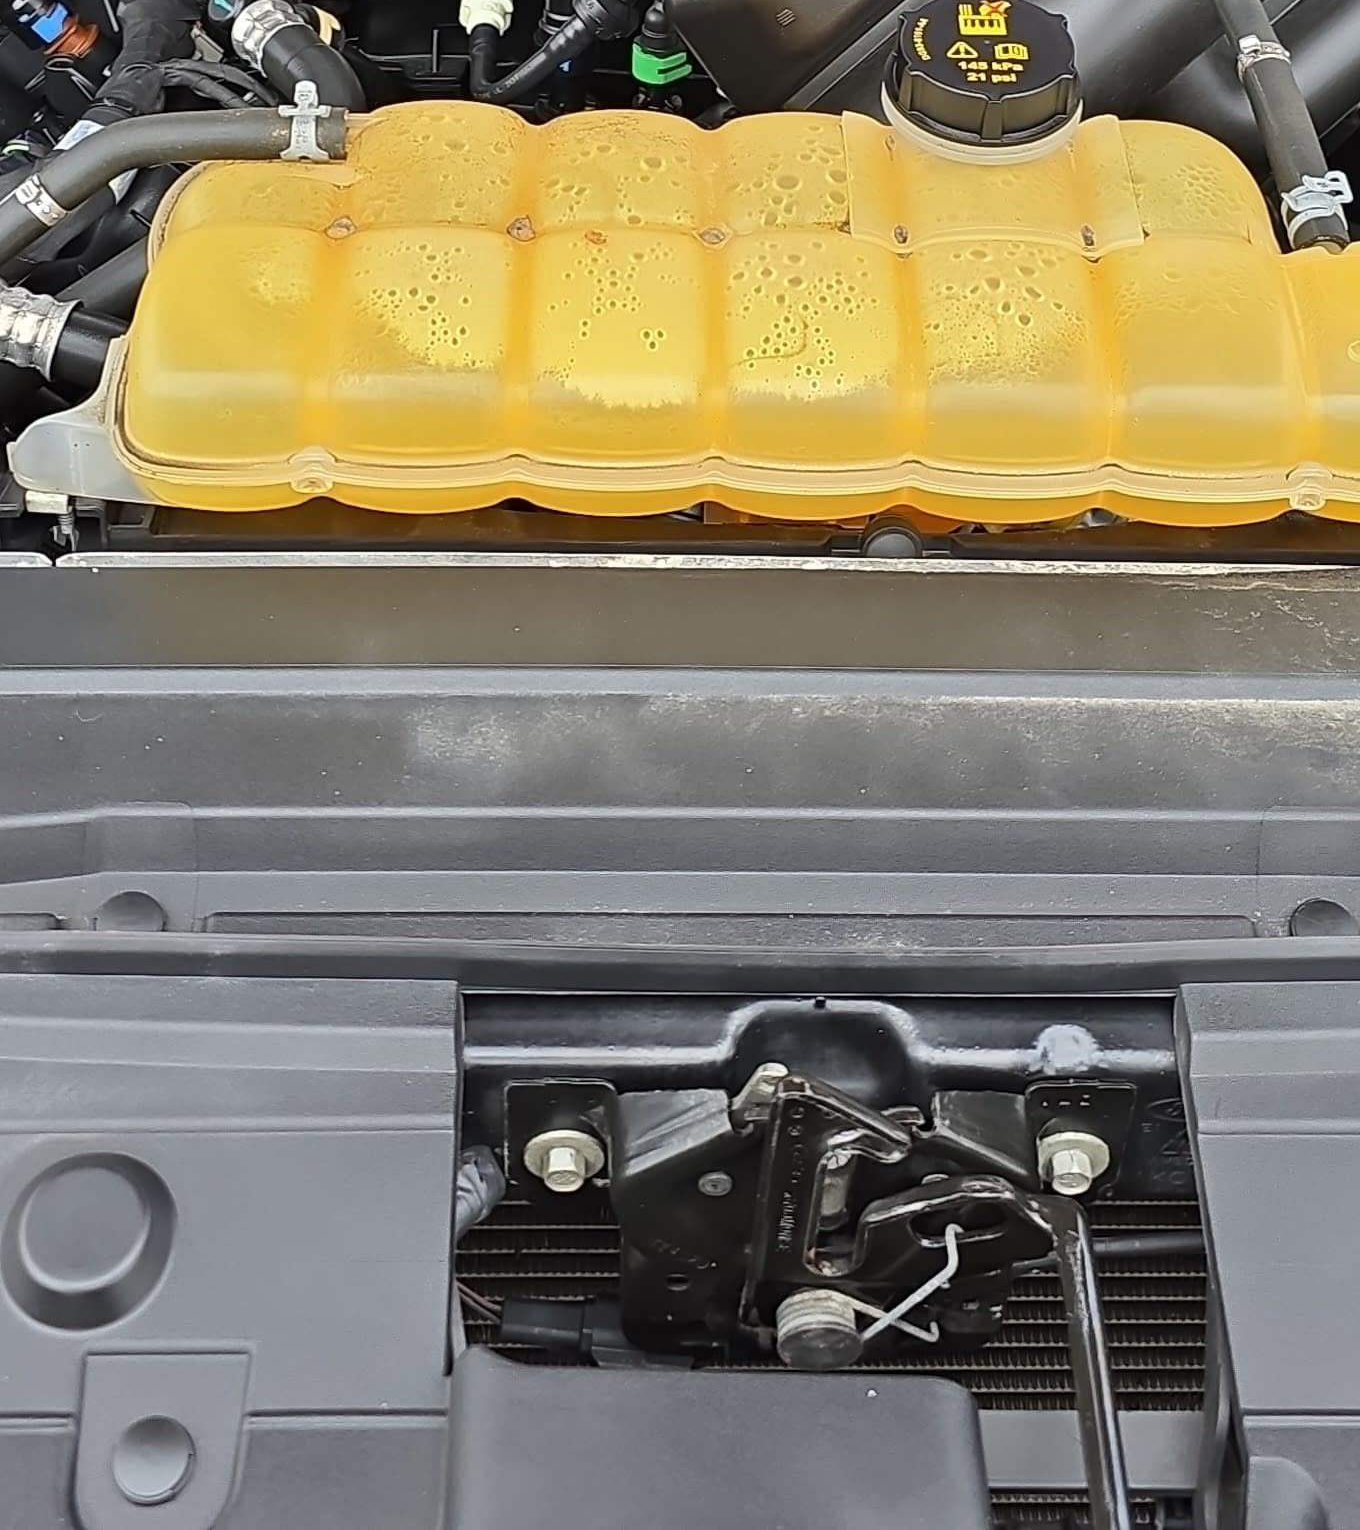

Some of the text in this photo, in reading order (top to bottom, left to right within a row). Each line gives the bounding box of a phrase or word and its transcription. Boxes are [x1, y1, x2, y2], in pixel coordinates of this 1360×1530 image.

[958, 61, 1024, 71] 145 kPa
[966, 73, 1017, 83] 21 psi
